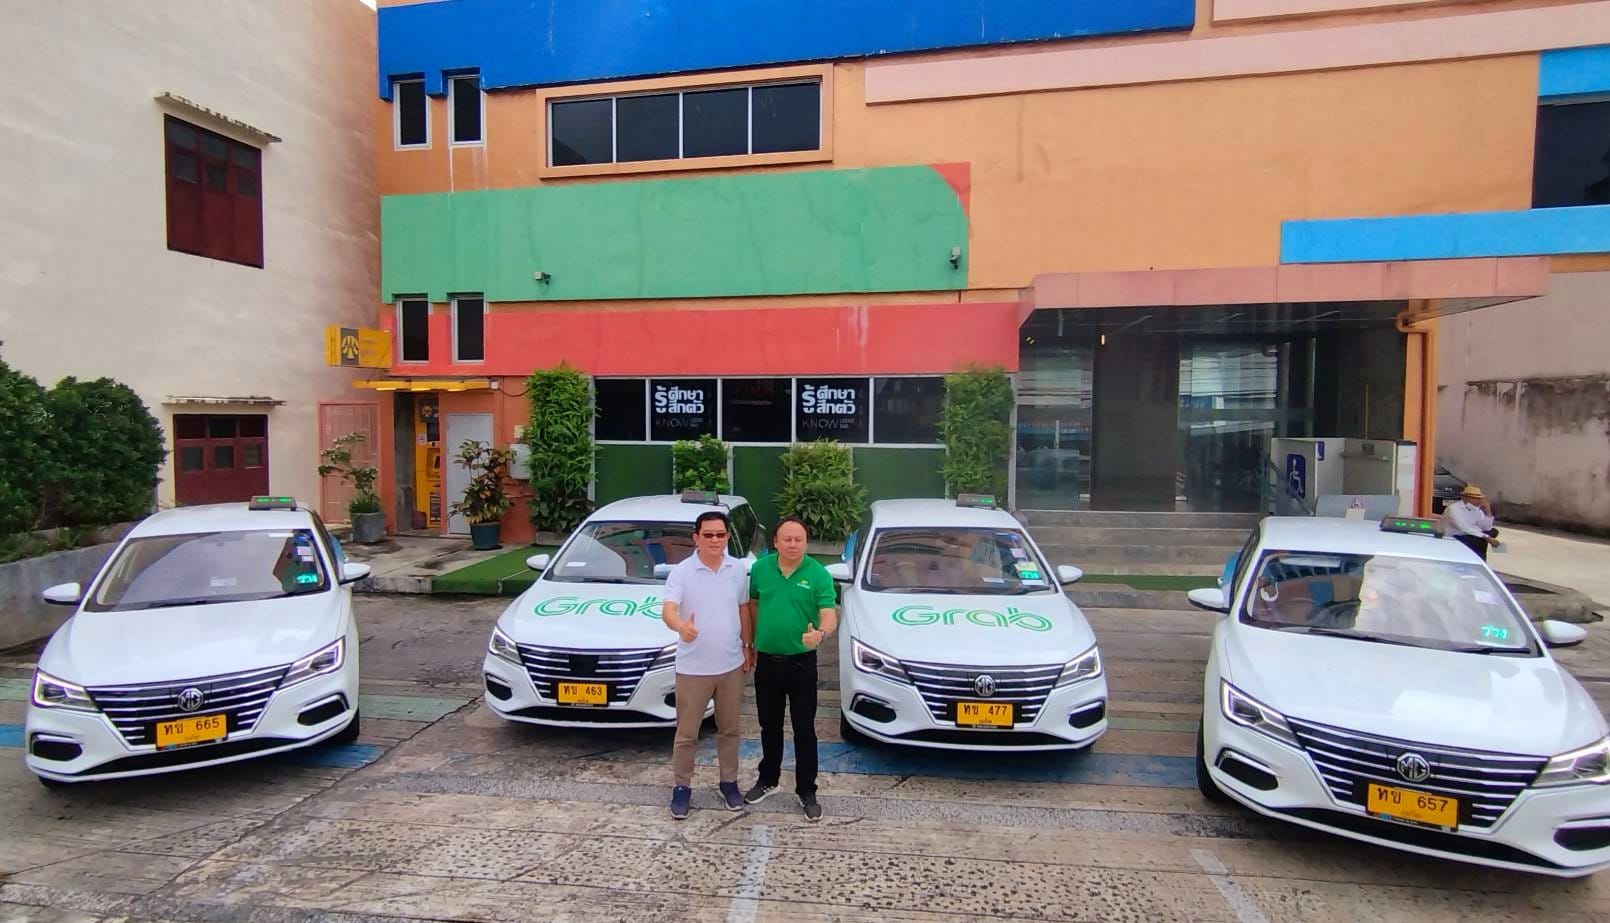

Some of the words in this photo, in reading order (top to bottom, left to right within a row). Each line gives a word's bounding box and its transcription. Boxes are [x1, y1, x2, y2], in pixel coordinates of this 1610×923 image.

[802, 418, 840, 429] KNOW
[534, 596, 664, 620] Grab
[891, 606, 1053, 632] Grab
[585, 686, 603, 696] 463
[975, 676, 995, 696] MG
[179, 688, 203, 711] MG
[988, 705, 1007, 716] 477
[195, 717, 220, 731] 665
[1398, 753, 1429, 781] MG
[1377, 788, 1401, 804] ทข
[1417, 796, 1448, 812] 657
